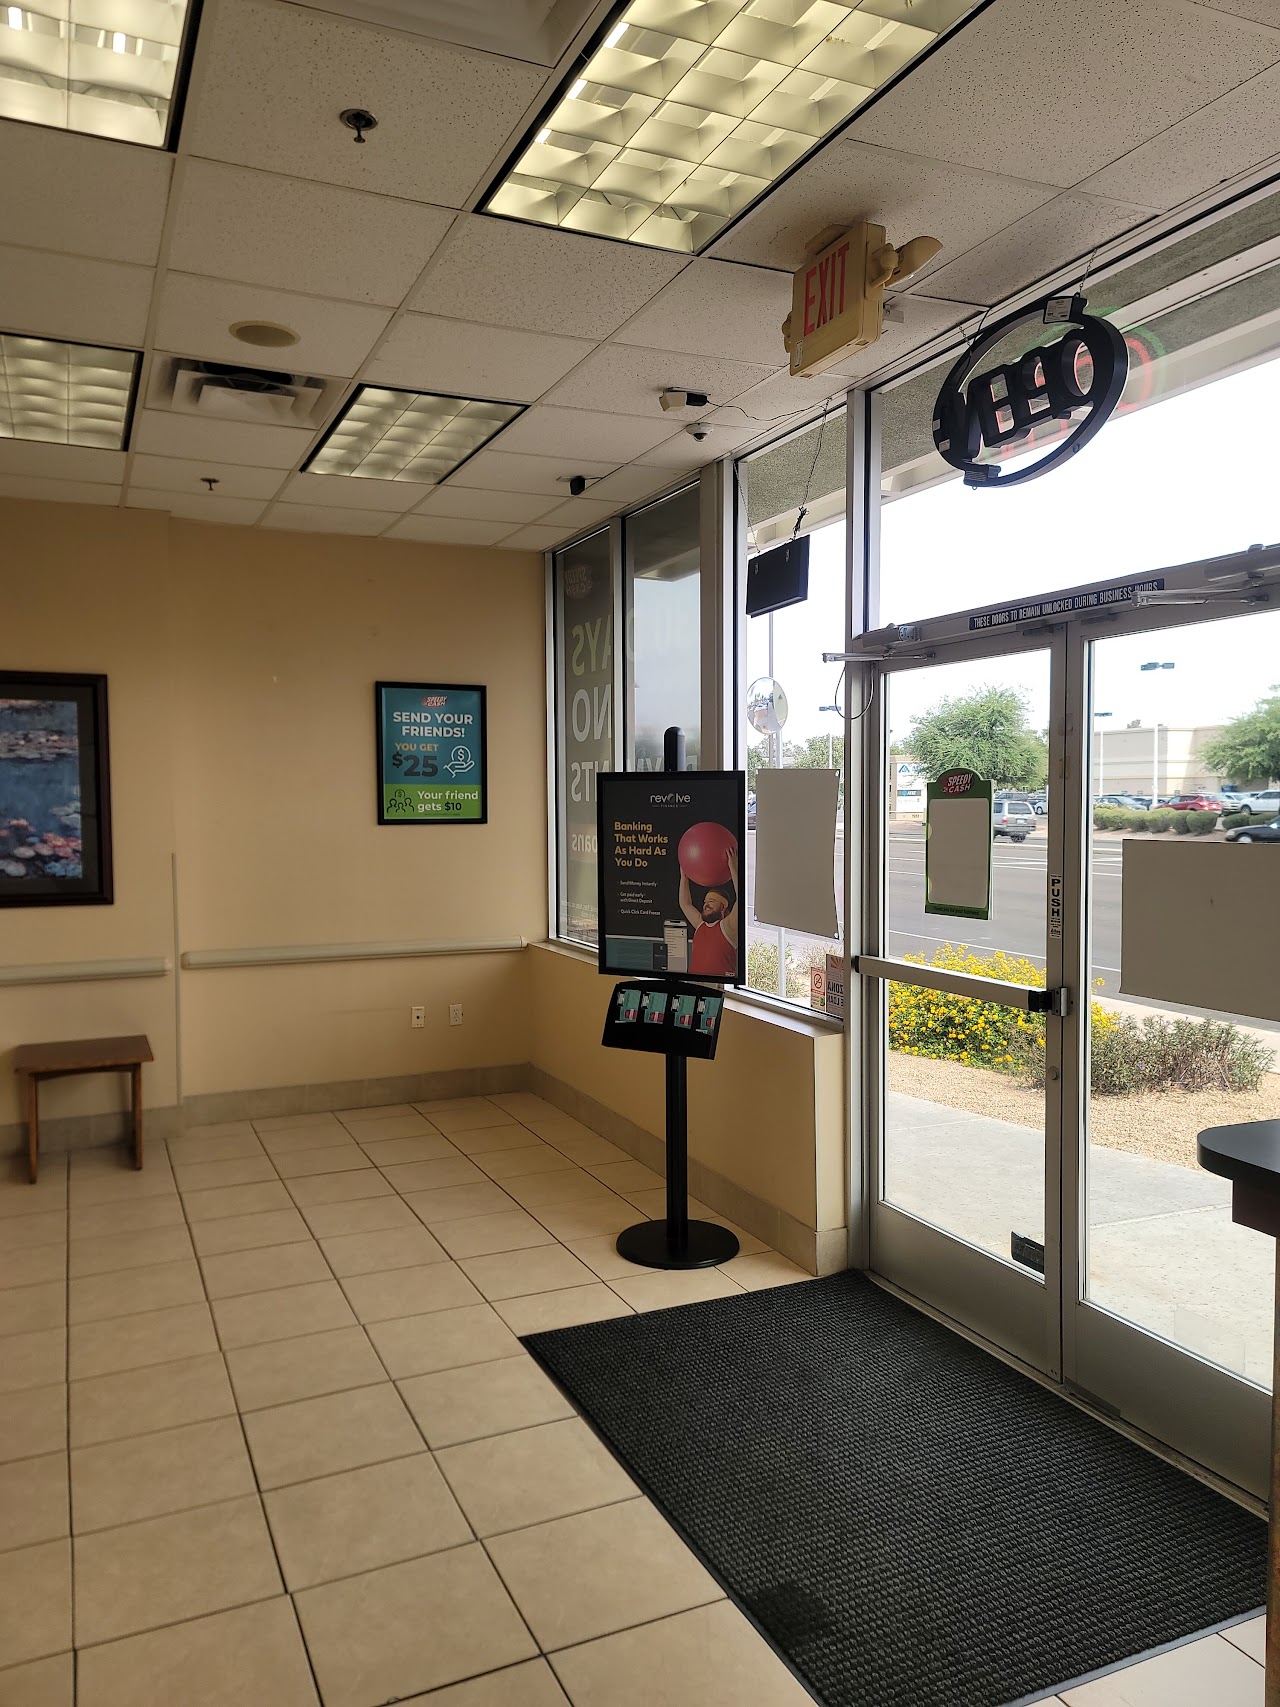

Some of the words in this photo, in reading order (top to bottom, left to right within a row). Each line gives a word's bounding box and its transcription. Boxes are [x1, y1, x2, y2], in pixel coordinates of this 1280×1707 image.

[803, 244, 850, 337] EXIT
[974, 615, 990, 628] THESE
[991, 611, 1009, 625] DOORS
[1010, 610, 1018, 621] TO
[1019, 605, 1041, 619] REMAIN
[1042, 599, 1073, 615] UNLOCKED
[1074, 593, 1098, 608] DURING
[1099, 586, 1132, 604] BUSINESS
[393, 711, 431, 723] SEND
[435, 713, 473, 725] YOUR
[402, 725, 465, 738] FRIENDS!
[395, 742, 417, 751] YOU
[420, 743, 439, 752] GET
[392, 752, 438, 777] $25
[948, 773, 973, 787] SPEEDY
[948, 783, 971, 793] CASH
[417, 790, 443, 800] Your
[445, 790, 479, 800] friend
[650, 793, 691, 803] revolve
[417, 802, 442, 813] gets
[444, 801, 462, 811] $10
[614, 821, 653, 833] Banking
[614, 833, 637, 843] That
[638, 833, 669, 844] Works
[614, 845, 627, 855] As
[629, 845, 652, 856] Hard
[654, 846, 667, 856] As
[615, 857, 633, 867] You
[634, 858, 648, 868] Do
[1051, 878, 1061, 917] PUSH
